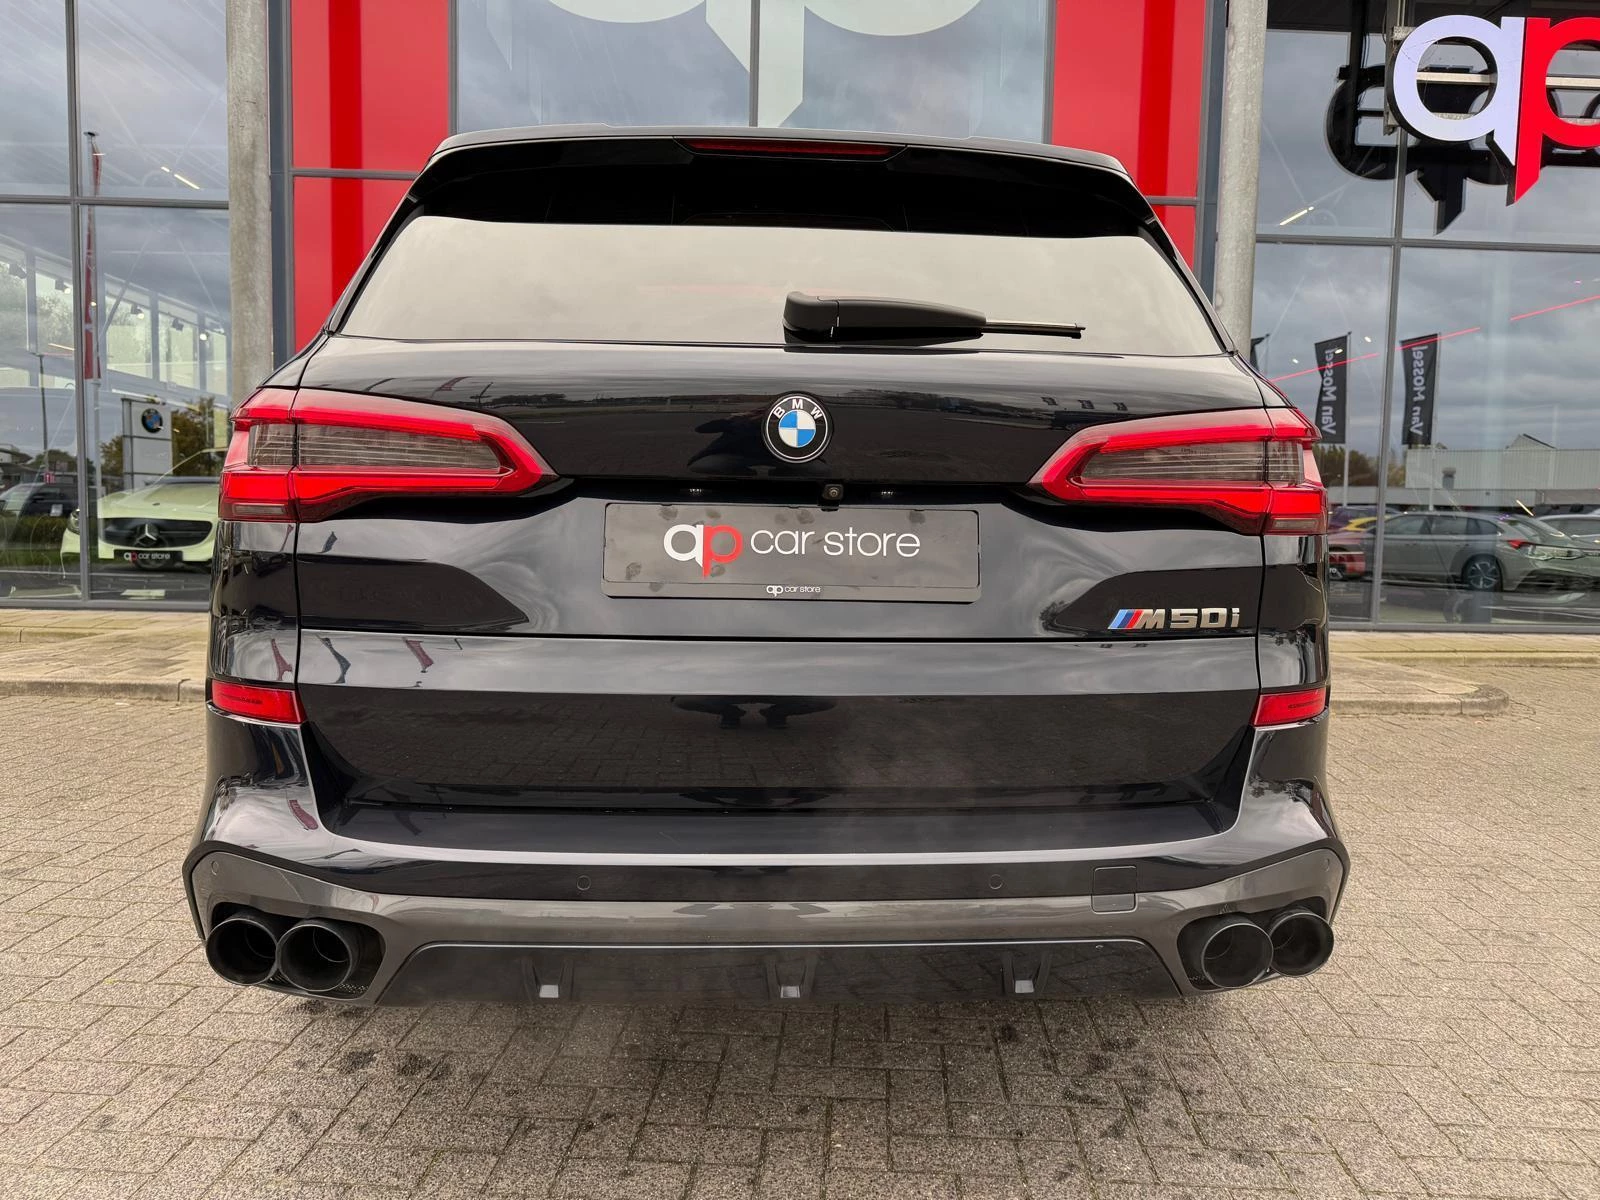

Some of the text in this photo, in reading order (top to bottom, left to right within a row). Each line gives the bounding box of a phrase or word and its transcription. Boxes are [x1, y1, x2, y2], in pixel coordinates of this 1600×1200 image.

[773, 399, 823, 420] BMW
[750, 529, 815, 555] car
[823, 527, 921, 557] store
[799, 585, 821, 593] store
